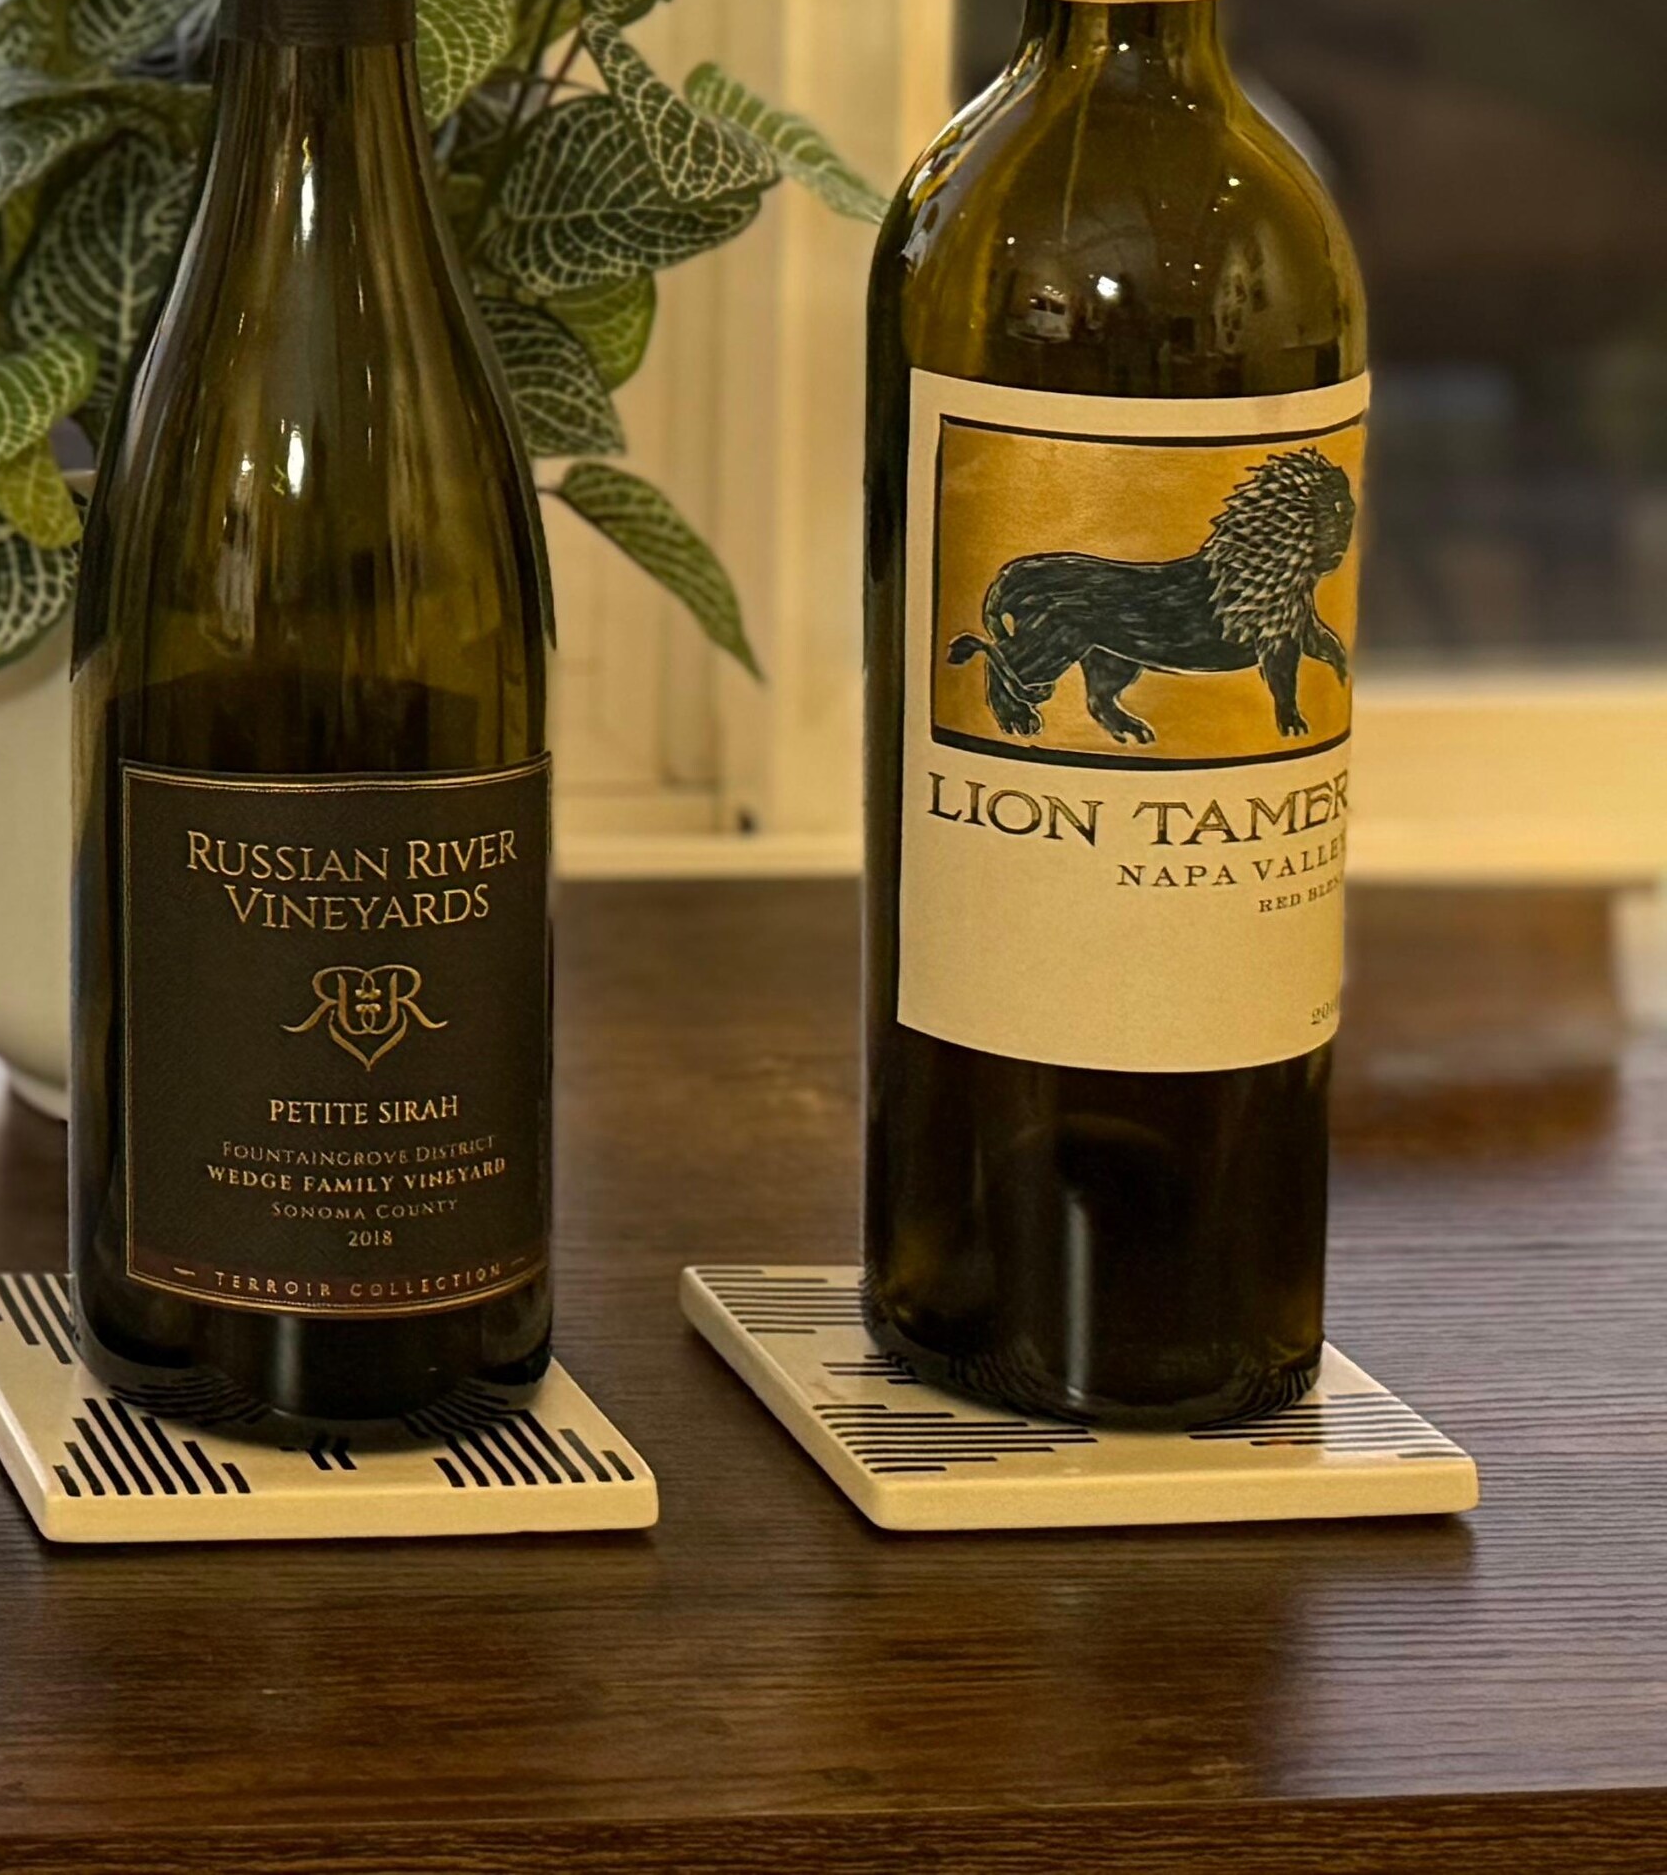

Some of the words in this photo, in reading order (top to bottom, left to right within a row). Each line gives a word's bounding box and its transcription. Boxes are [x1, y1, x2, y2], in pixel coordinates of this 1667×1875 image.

[928, 771, 1104, 847] LION
[1133, 768, 1349, 847] TAMER
[186, 828, 389, 883] RUSSIAN
[406, 828, 518, 880] RIVER
[1116, 861, 1237, 888] NAPA
[222, 883, 491, 931] VINEYARDS
[1258, 892, 1302, 913] RED
[267, 1099, 369, 1125] PETITE
[378, 1094, 459, 1124] SIRAH
[222, 1140, 409, 1167] FOUNTAINGROVE
[415, 1134, 496, 1164] DISTRICT
[206, 1164, 292, 1192] WEDGE
[303, 1175, 394, 1193] FAMILY
[403, 1157, 506, 1190] VINEYARD
[270, 1201, 366, 1221] SONOMA
[375, 1198, 458, 1220] COUNTY
[348, 1230, 393, 1247] 2018
[214, 1270, 331, 1298] TERROIR
[350, 1262, 501, 1298] COLLECTION
